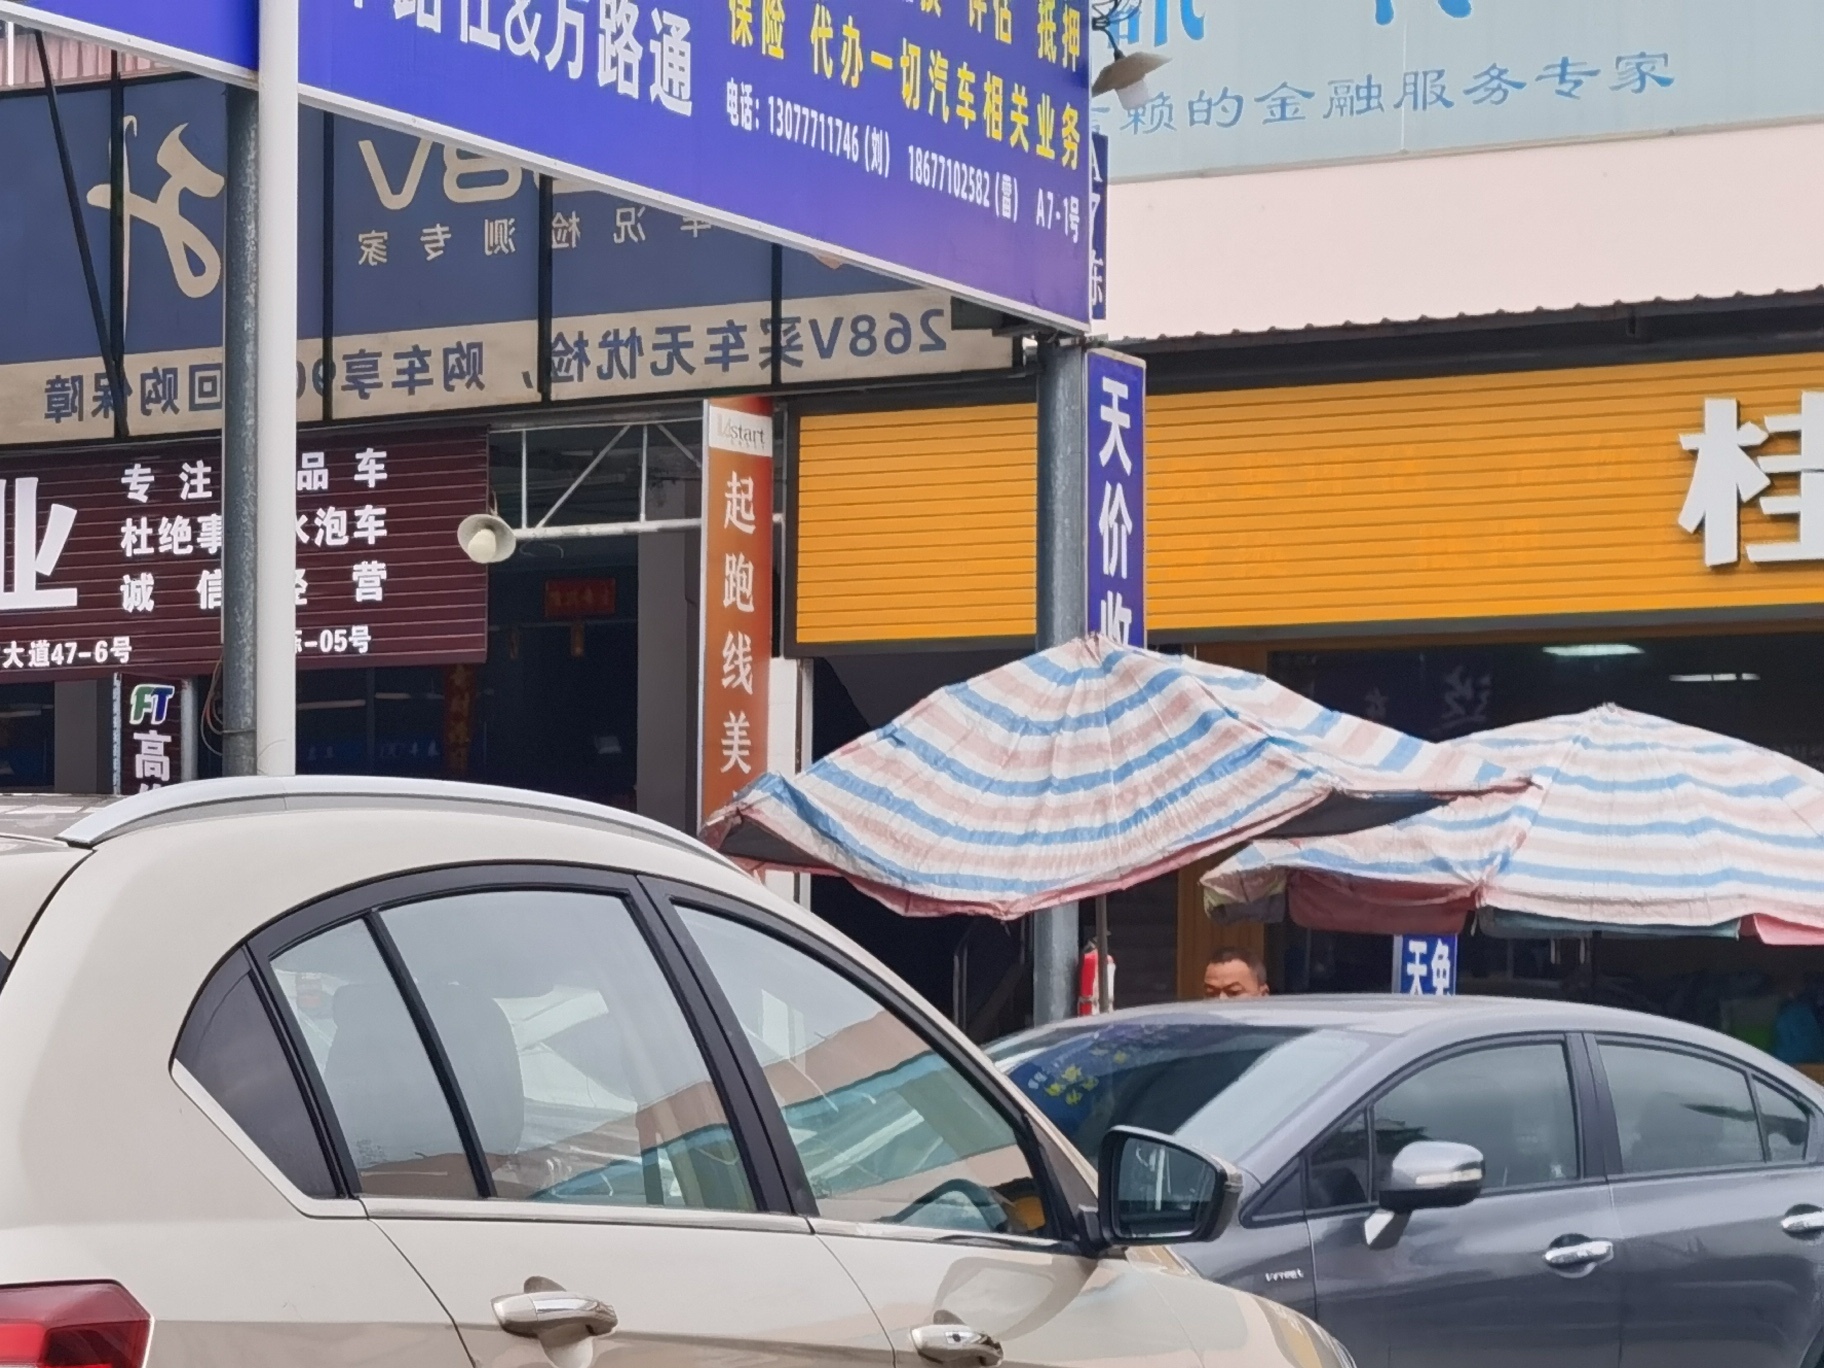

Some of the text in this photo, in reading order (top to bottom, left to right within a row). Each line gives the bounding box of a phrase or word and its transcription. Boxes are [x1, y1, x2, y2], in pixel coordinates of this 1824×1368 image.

[810, 4, 1081, 170] 代办一切汽车相关业务
[129, 683, 175, 724] FT
[720, 470, 757, 797] 起跑线美
